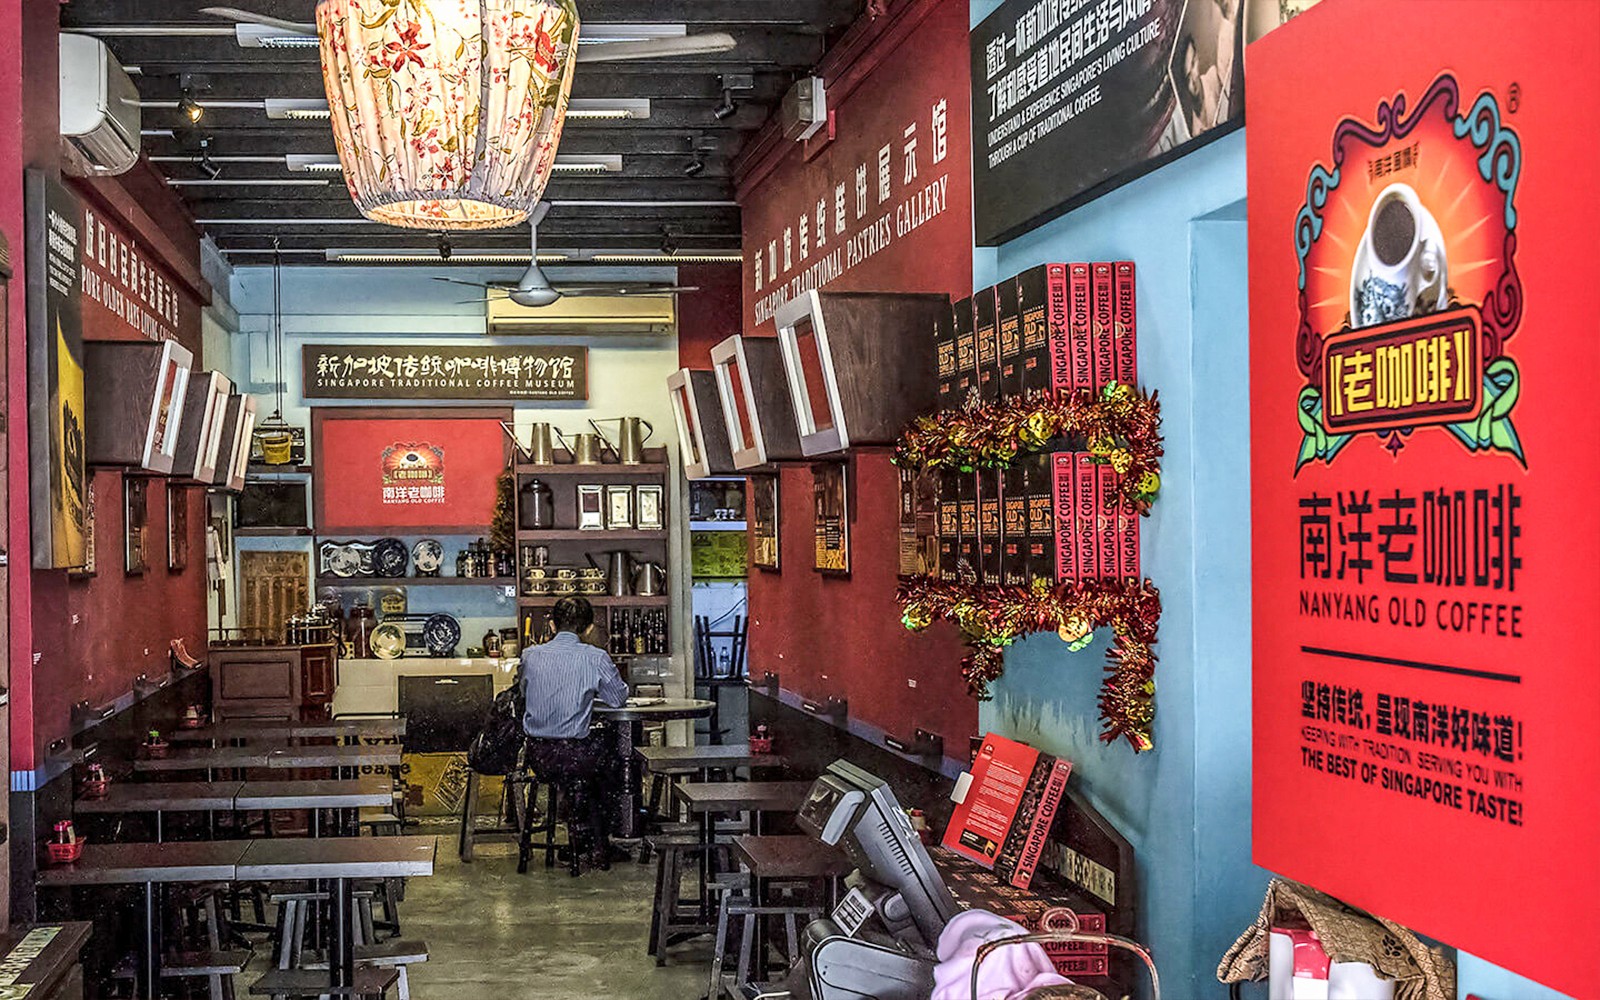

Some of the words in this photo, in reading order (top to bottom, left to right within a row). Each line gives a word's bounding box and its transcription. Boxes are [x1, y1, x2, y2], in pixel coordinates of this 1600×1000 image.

[987, 113, 1021, 147] UNDERSTAND
[1021, 110, 1026, 126] &
[1026, 86, 1061, 122] EXPERIENCE
[1103, 42, 1125, 72] LIVING
[1126, 17, 1161, 55] CULTURE
[988, 142, 1012, 169] THROUGH
[1017, 131, 1028, 150] CUP
[1029, 126, 1036, 143] OF
[1037, 102, 1074, 138] TRADITIONAL
[791, 248, 843, 298] TRADITIONAL
[847, 213, 892, 269] PASTRIES
[896, 174, 948, 238] GALLERY
[1052, 292, 1065, 326] COFFEE
[1075, 292, 1086, 326] COFFEE
[1098, 291, 1109, 326] COFFEE
[1120, 290, 1132, 324] COFFEE
[316, 354, 575, 379] 新加坡传统咖啡博物馆
[1053, 328, 1068, 384] SINGAPORE
[1077, 328, 1089, 384] SINGAPORE
[1100, 328, 1111, 383] SINGAPORE
[1121, 327, 1133, 381] SINGAPORE
[317, 378, 384, 387] SINGAPORE
[391, 379, 470, 388] TRADITIONAL
[476, 379, 519, 388] COFFEE
[526, 379, 574, 388] MUSEUM
[382, 486, 445, 498] 南洋老咖啡
[1059, 481, 1071, 516] COFFEE
[1081, 481, 1092, 516] COFFEE
[1061, 519, 1073, 574] SINGAPORE
[1082, 518, 1094, 574] SINGAPORE
[1104, 518, 1115, 574] SINGAPORE
[1124, 518, 1137, 573] SINGAPORE
[1299, 483, 1522, 592] 南洋老咖啡
[1299, 590, 1380, 623] NANYANG
[1389, 597, 1426, 628] OLD
[1436, 600, 1522, 638] COFFEE
[1302, 726, 1335, 748] KEEPING
[1339, 733, 1360, 749] WITH
[1417, 752, 1462, 779] SERVING
[1466, 763, 1489, 785] YOU
[1494, 770, 1523, 792] WITH
[1301, 747, 1323, 771] THE
[1327, 754, 1357, 780] BEST
[1362, 763, 1378, 785] OF
[1381, 767, 1462, 810] SINGAPORE
[1467, 789, 1523, 828] TASTE!
[1022, 818, 1048, 868] SINGAPORE
[1040, 784, 1061, 818] COFFEE
